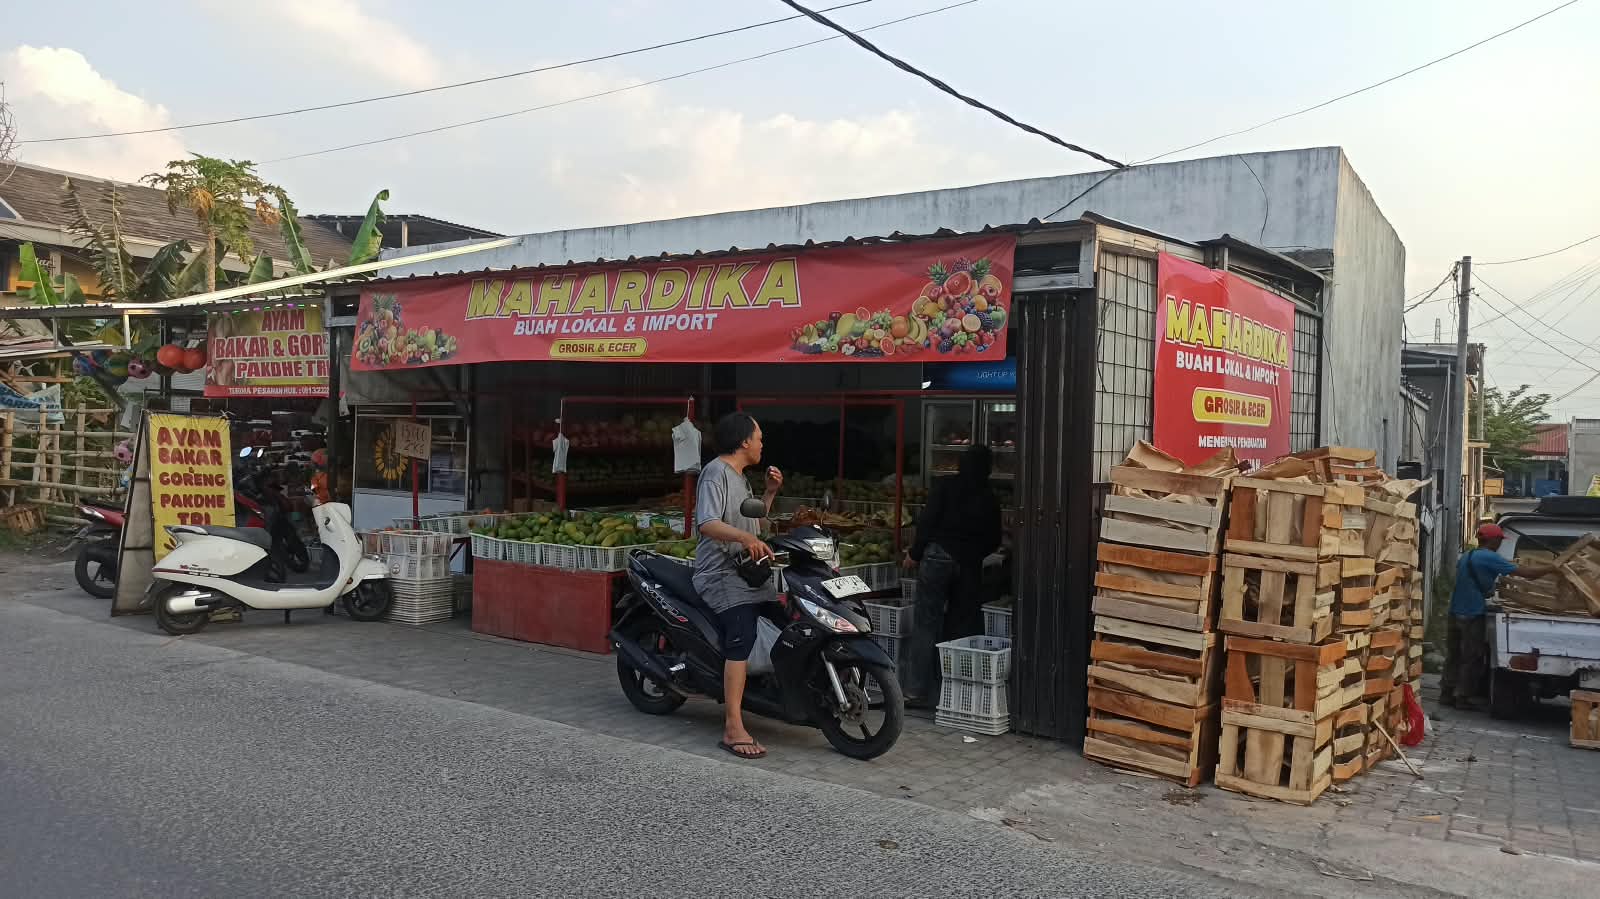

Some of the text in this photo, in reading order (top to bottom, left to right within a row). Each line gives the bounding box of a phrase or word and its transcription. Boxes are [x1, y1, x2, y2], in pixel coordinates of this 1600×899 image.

[465, 257, 801, 320] MAHARDIKA
[262, 309, 305, 331] AYAM
[514, 313, 718, 336] BUAH LOKAL & IMPORT
[1165, 294, 1289, 369] MAHARDIKA
[216, 337, 269, 358] BAKAR
[273, 339, 284, 356] &
[558, 342, 637, 354] GROSIR & ECER
[237, 361, 302, 377] PAKDHE
[1176, 351, 1280, 386] BUAH LOKAL & IMPORT
[1204, 395, 1266, 418] GROSIR & ECER
[157, 427, 222, 448] AYAM
[158, 448, 223, 466] BAKAR
[159, 472, 226, 487] GORENG
[160, 494, 226, 508] PAKDHE
[177, 512, 212, 526] TRI
